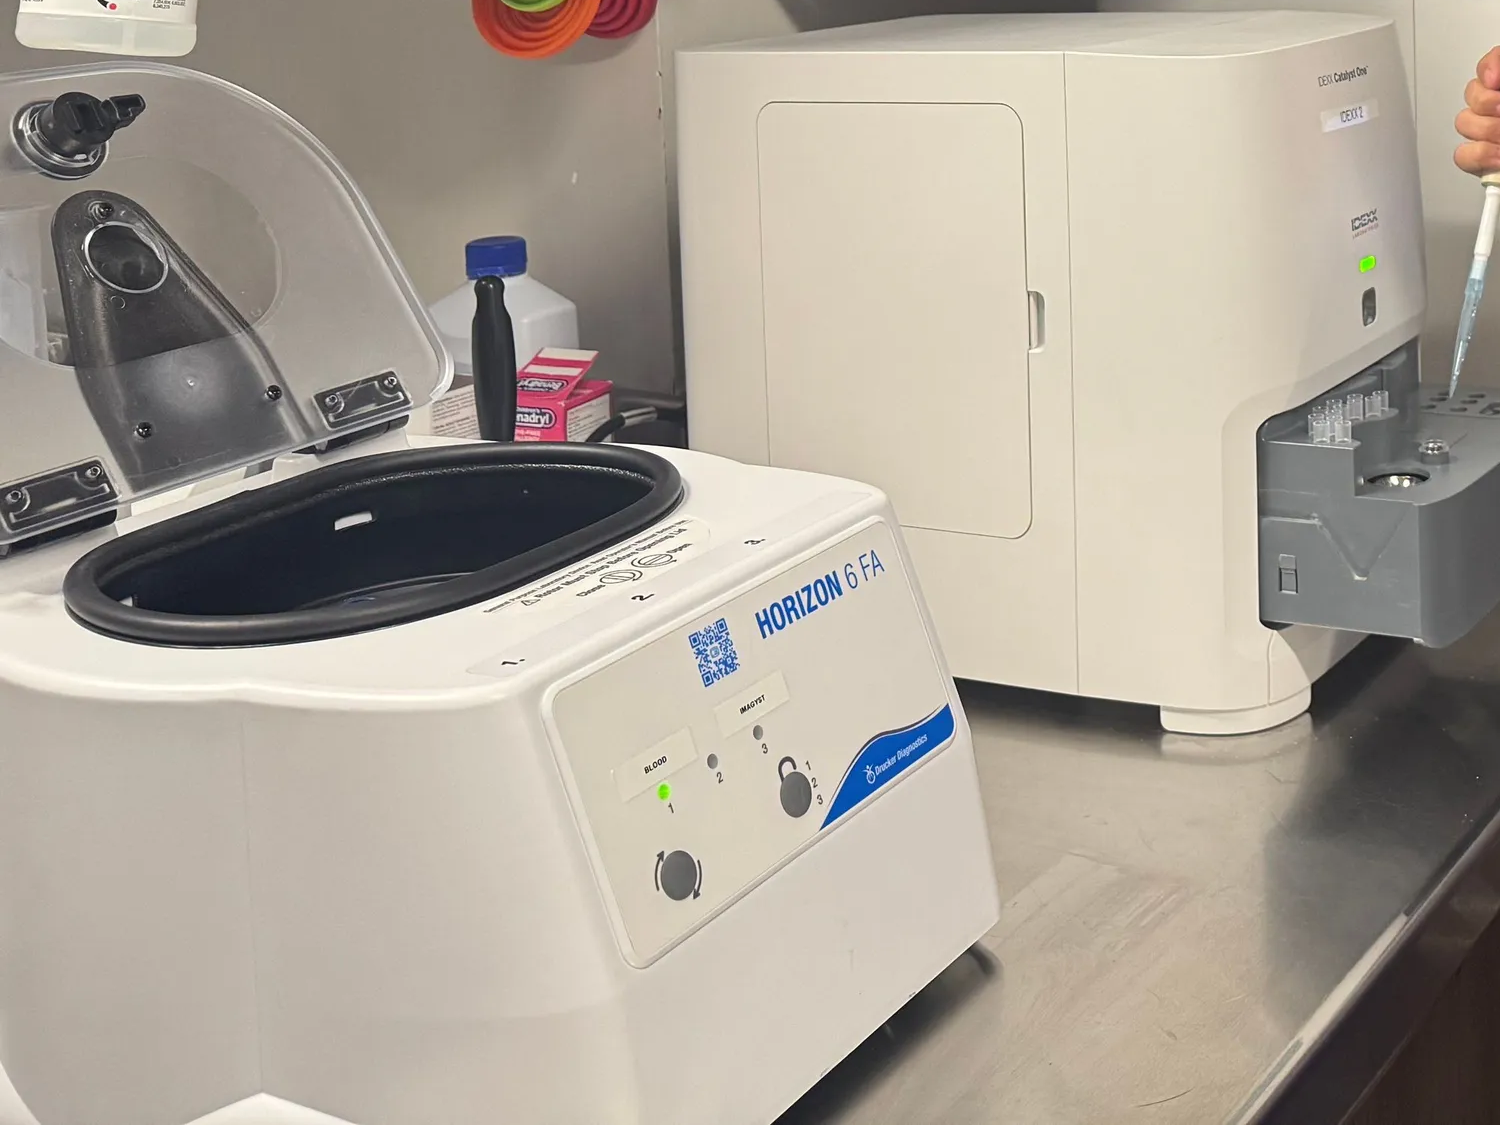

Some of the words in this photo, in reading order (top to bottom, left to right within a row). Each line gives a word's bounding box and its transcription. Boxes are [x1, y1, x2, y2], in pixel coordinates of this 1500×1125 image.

[1334, 69, 1356, 84] Catalyst
[1356, 66, 1368, 76] One
[1340, 108, 1358, 123] IDEXX
[1358, 106, 1364, 118] 2
[516, 410, 550, 426] nadryl
[536, 585, 563, 599] Rotor
[564, 574, 586, 587] Must
[585, 564, 610, 579] Stop
[608, 549, 638, 567] Before
[636, 532, 674, 552] Opening
[754, 570, 844, 640] HORIZON
[844, 562, 858, 590] 6
[858, 549, 886, 582] FA
[739, 694, 766, 715] IMAGYST
[762, 742, 769, 754] 3
[874, 755, 897, 776] Drucker
[896, 734, 928, 761] Diagnostics
[643, 755, 668, 775] BLOOD
[805, 760, 812, 771] 1
[716, 772, 724, 784] 2
[811, 777, 818, 788] 2
[816, 794, 824, 805] 3
[668, 802, 675, 814] 1
